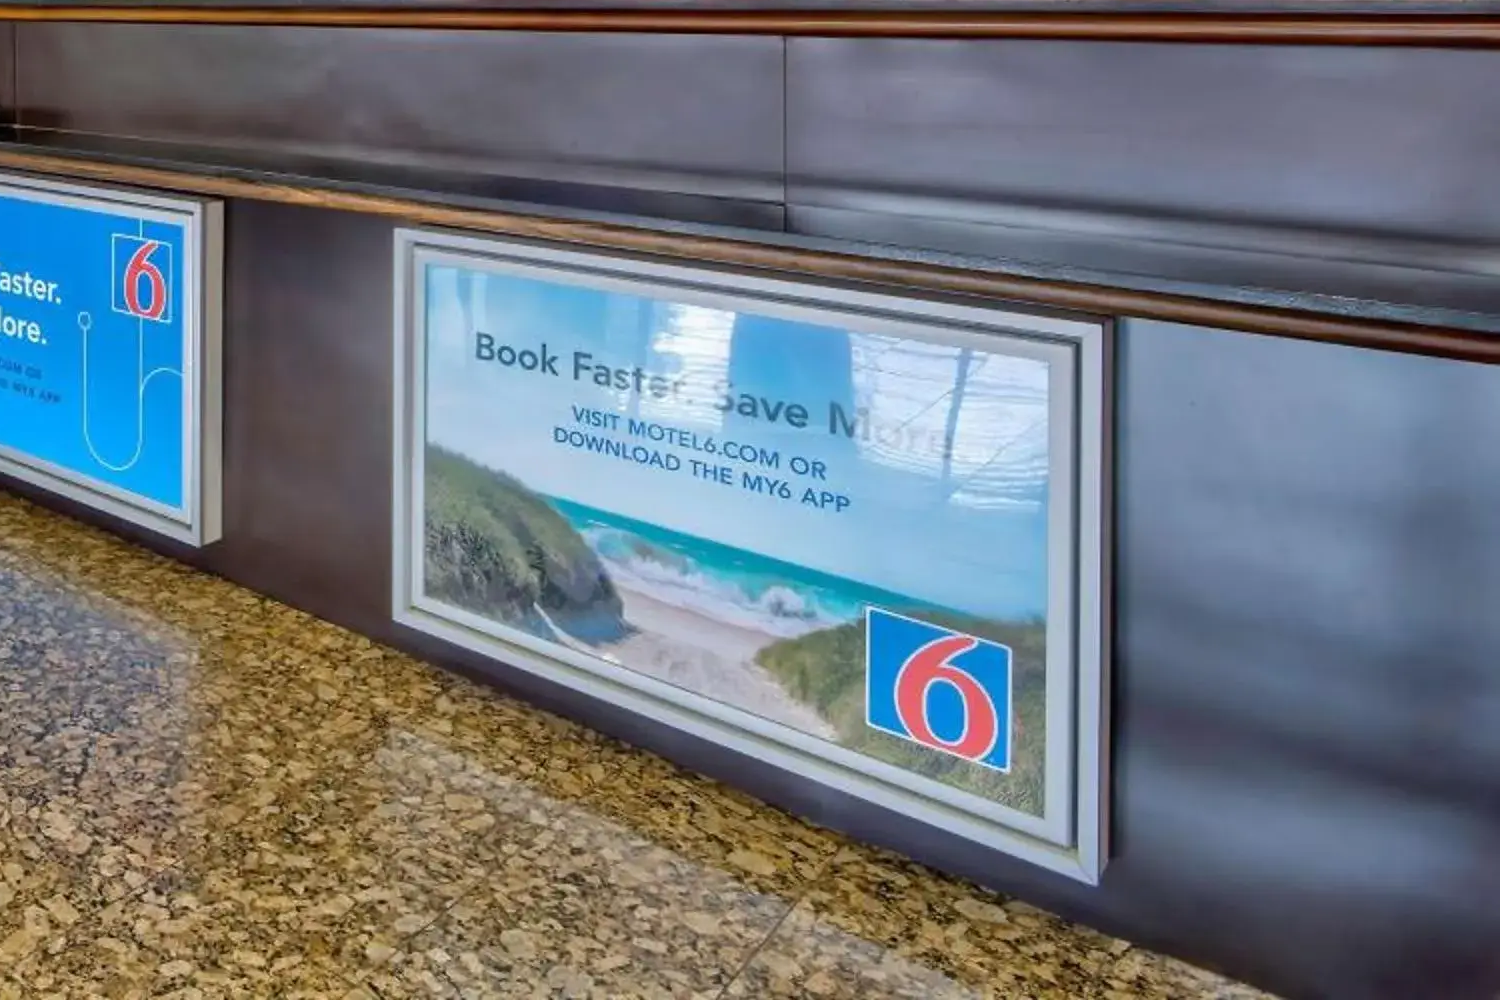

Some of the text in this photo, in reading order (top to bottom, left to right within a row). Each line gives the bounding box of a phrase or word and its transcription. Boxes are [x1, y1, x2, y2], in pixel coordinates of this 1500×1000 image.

[124, 240, 166, 321] 6
[475, 332, 559, 377] Book
[553, 426, 851, 512] DOWNLOAD THE MY6 APP
[572, 404, 827, 480] VISIT MOTEL6.COM OR
[894, 633, 998, 762] 6
